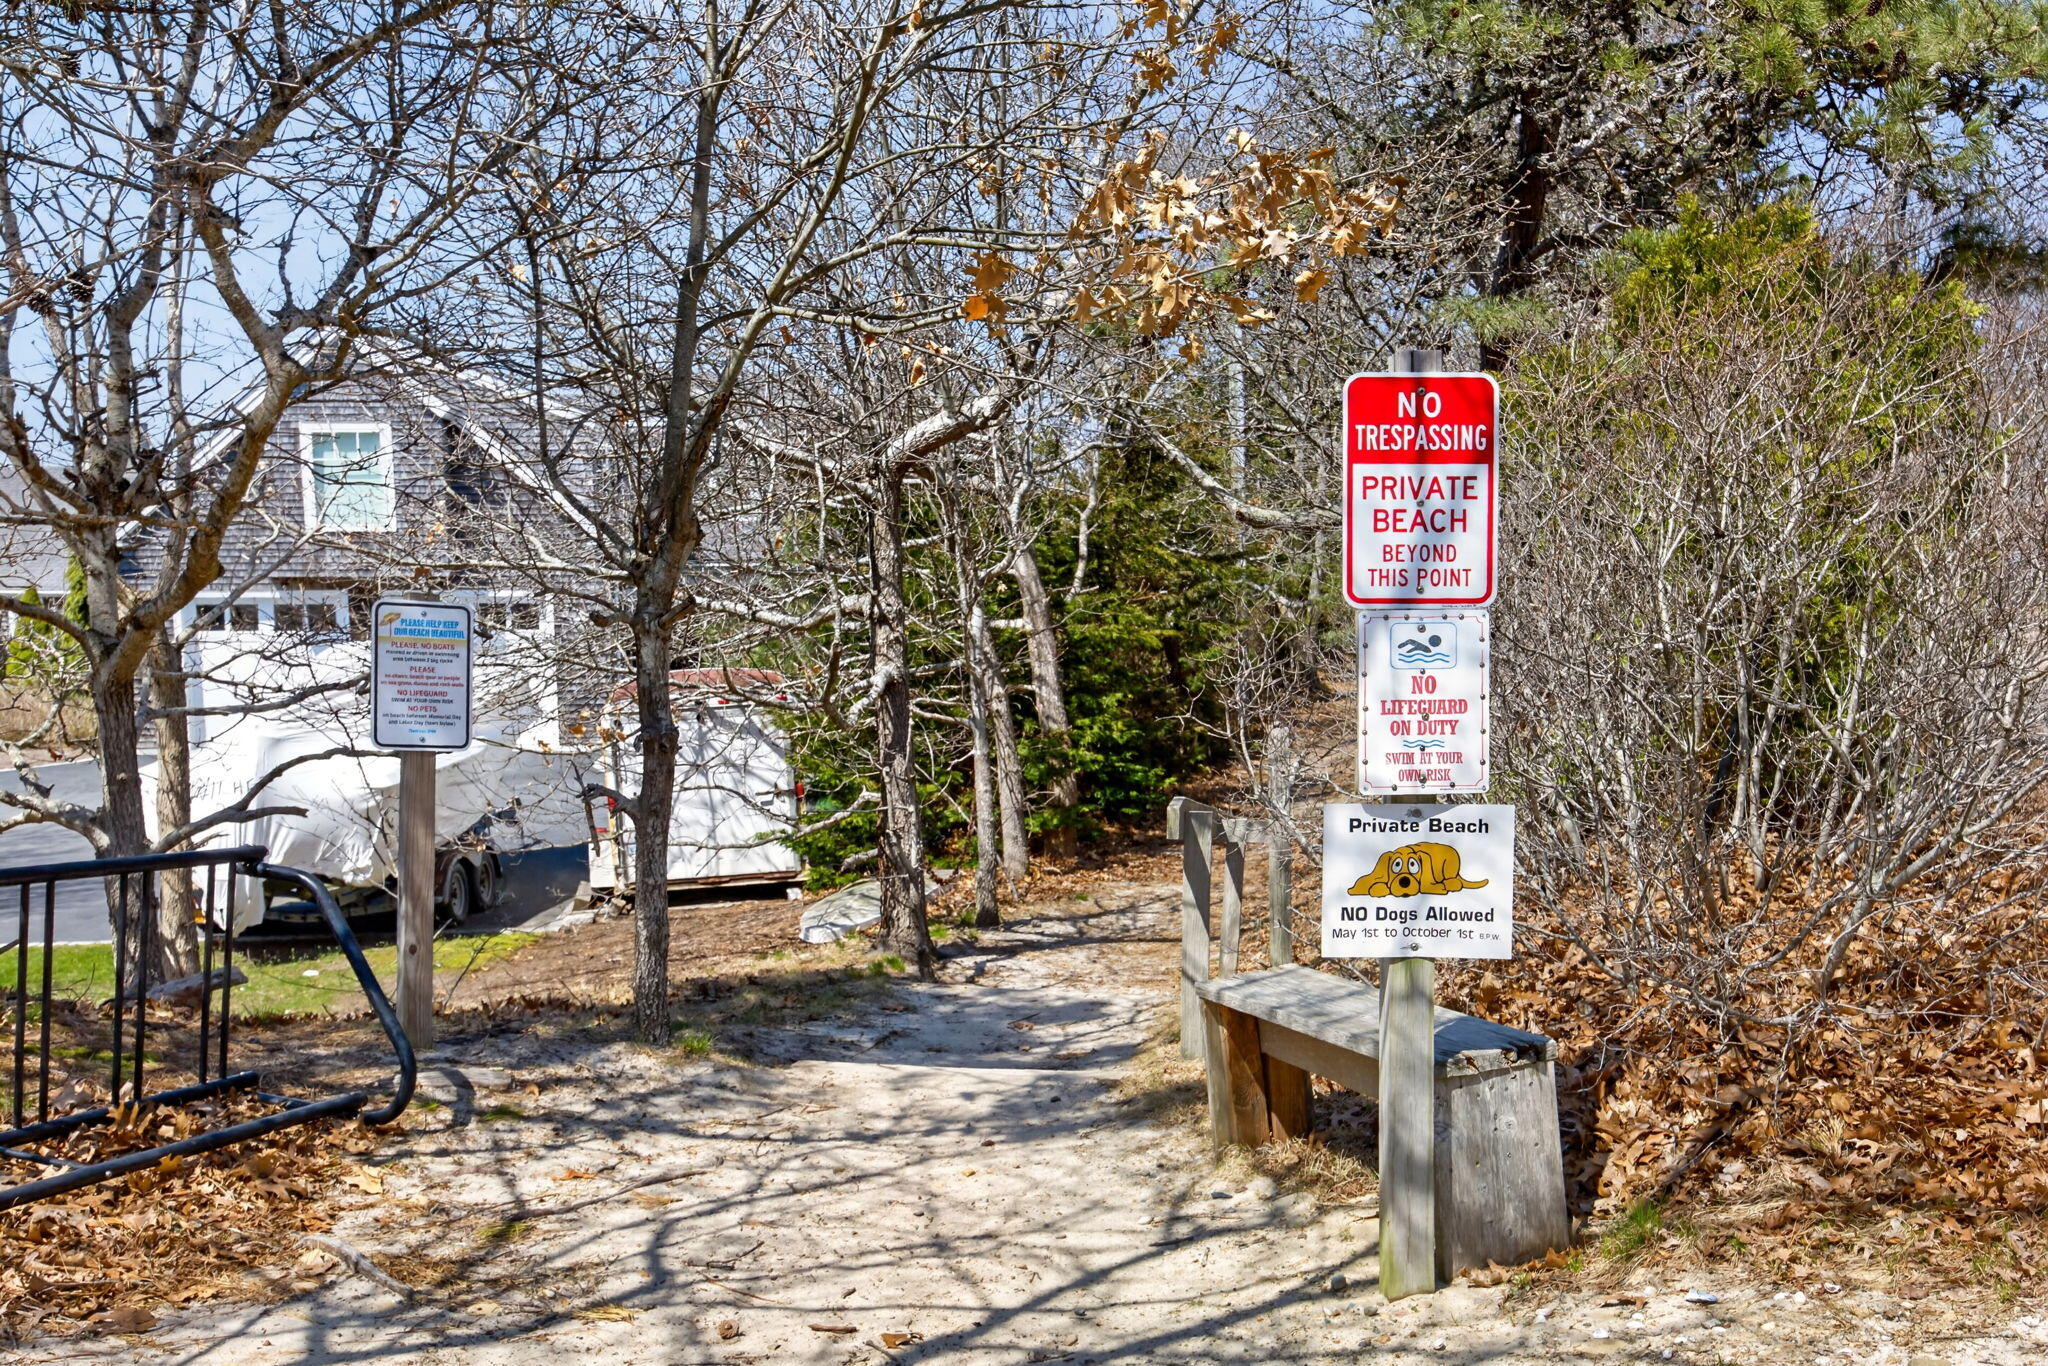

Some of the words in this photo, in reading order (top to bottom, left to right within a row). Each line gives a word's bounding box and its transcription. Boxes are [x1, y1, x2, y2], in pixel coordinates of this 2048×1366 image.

[1397, 392, 1442, 418] NO
[1355, 425, 1487, 451] TRESPASSING
[1362, 476, 1478, 500] PRIVATE
[1373, 509, 1467, 533] BEACH
[1382, 544, 1457, 563] BEYOND
[1367, 569, 1408, 587] THIS
[1417, 569, 1471, 587] POINT
[400, 618, 424, 627] PLEASE
[426, 620, 441, 628] HELP
[443, 621, 460, 629] KEEP
[394, 627, 408, 636] OUR
[408, 628, 430, 637] BEACH
[431, 629, 465, 639] BEAUTIFUL
[1411, 675, 1437, 694] NO
[1380, 699, 1468, 716] LIFEGUARD
[1390, 720, 1411, 736] ON
[1417, 720, 1459, 736] DUTY
[1385, 752, 1415, 765] SWIM
[1420, 752, 1434, 764] AT
[1435, 751, 1463, 764] YOUR
[1398, 769, 1422, 782] OWN
[1426, 769, 1451, 781] RISK
[1349, 818, 1420, 833] Private
[1429, 818, 1489, 834] Beach
[1341, 906, 1367, 921] NO
[1376, 907, 1418, 924] Dogs
[1425, 906, 1494, 922] Allowed
[1332, 928, 1357, 939] May
[1362, 927, 1379, 938] 1st
[1385, 927, 1398, 938] to
[1402, 927, 1451, 938] October
[1457, 929, 1474, 939] 1st
[1479, 932, 1501, 940] B.P.W.
